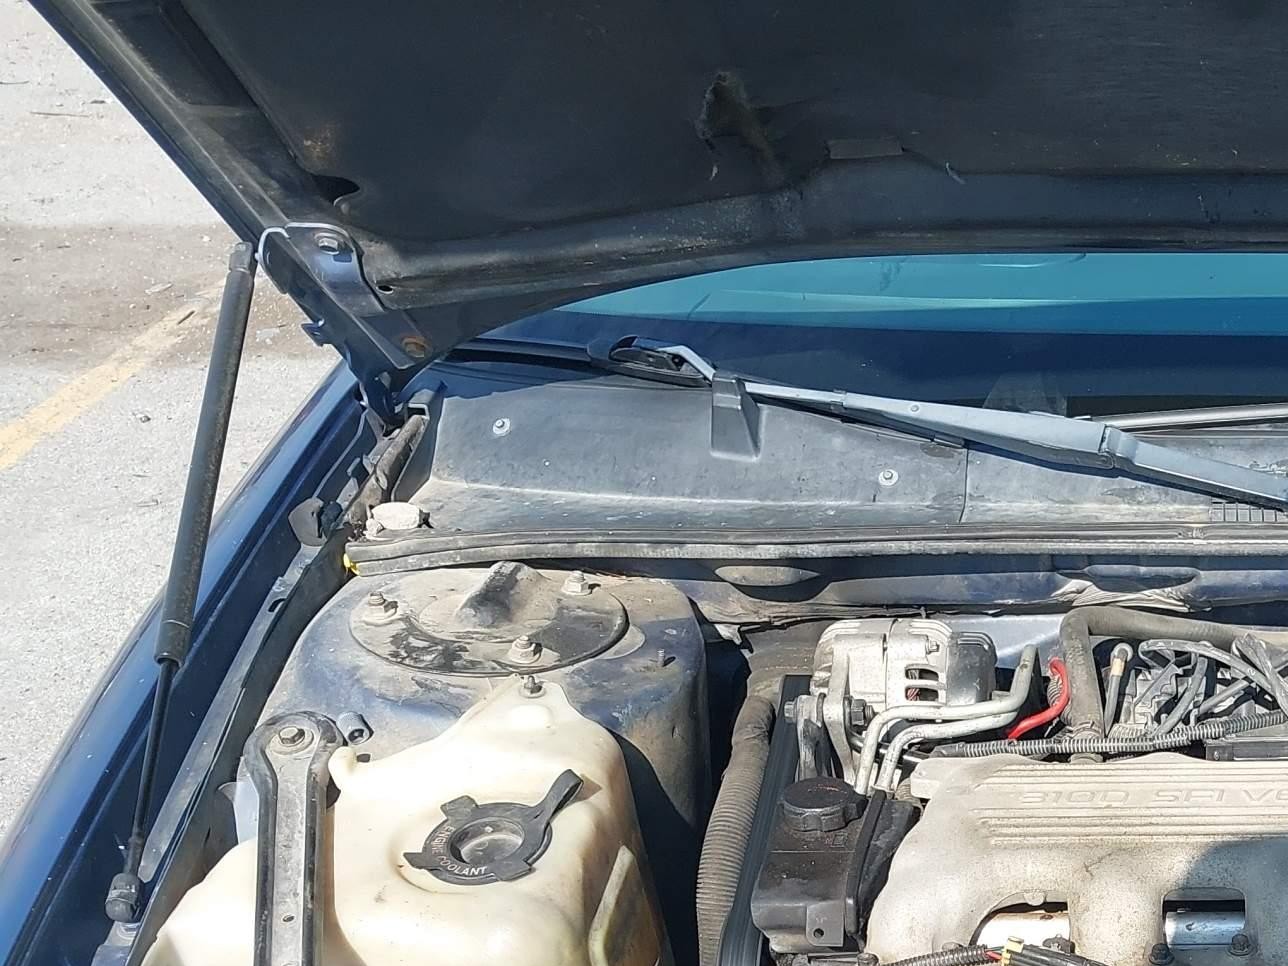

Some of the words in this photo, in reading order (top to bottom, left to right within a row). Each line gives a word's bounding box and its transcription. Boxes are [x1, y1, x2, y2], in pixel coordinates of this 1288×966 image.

[1150, 788, 1224, 804] SFI
[431, 825, 455, 856] ENGINE
[439, 855, 488, 876] COOLANT
